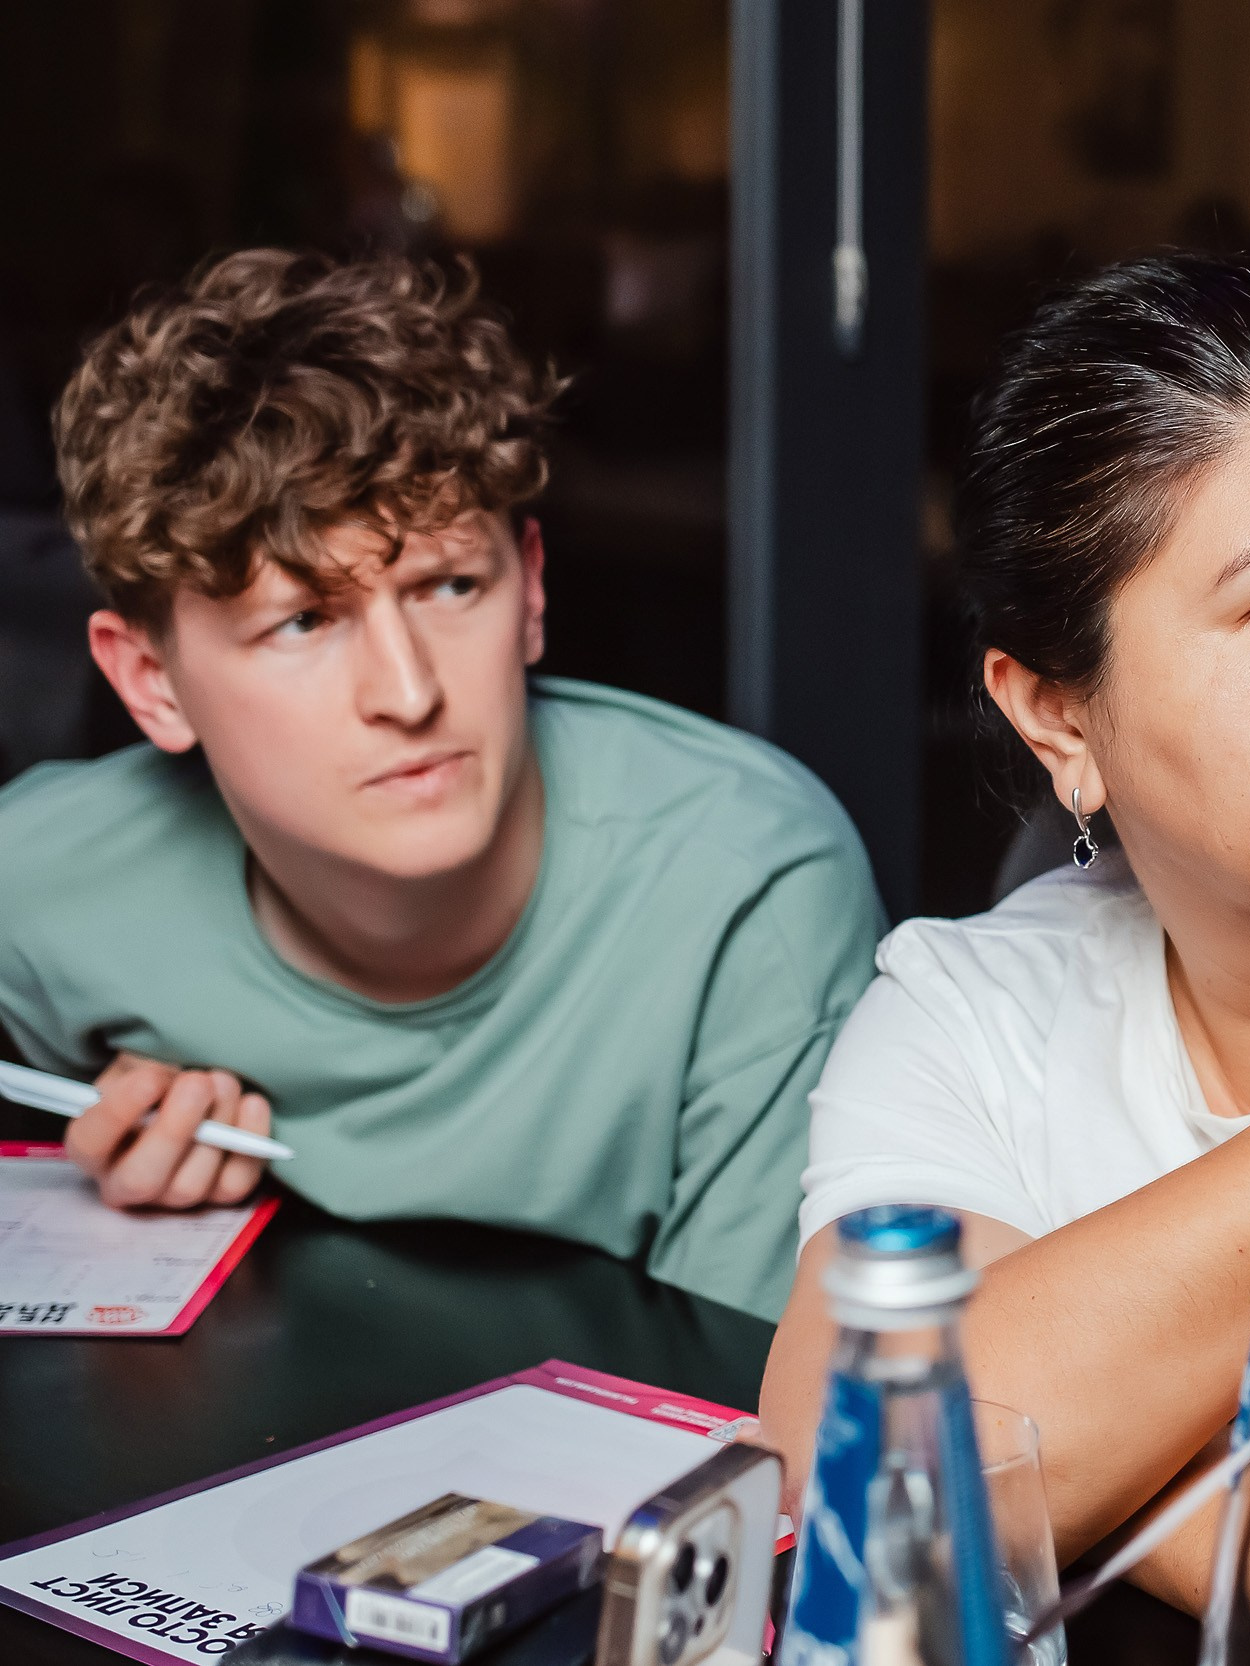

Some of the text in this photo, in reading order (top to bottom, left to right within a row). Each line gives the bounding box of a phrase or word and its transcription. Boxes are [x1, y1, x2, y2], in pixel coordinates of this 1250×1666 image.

[29, 1576, 237, 1654] ОСТО ЛИСТ
[86, 1572, 237, 1629] ЗАПИСИ
